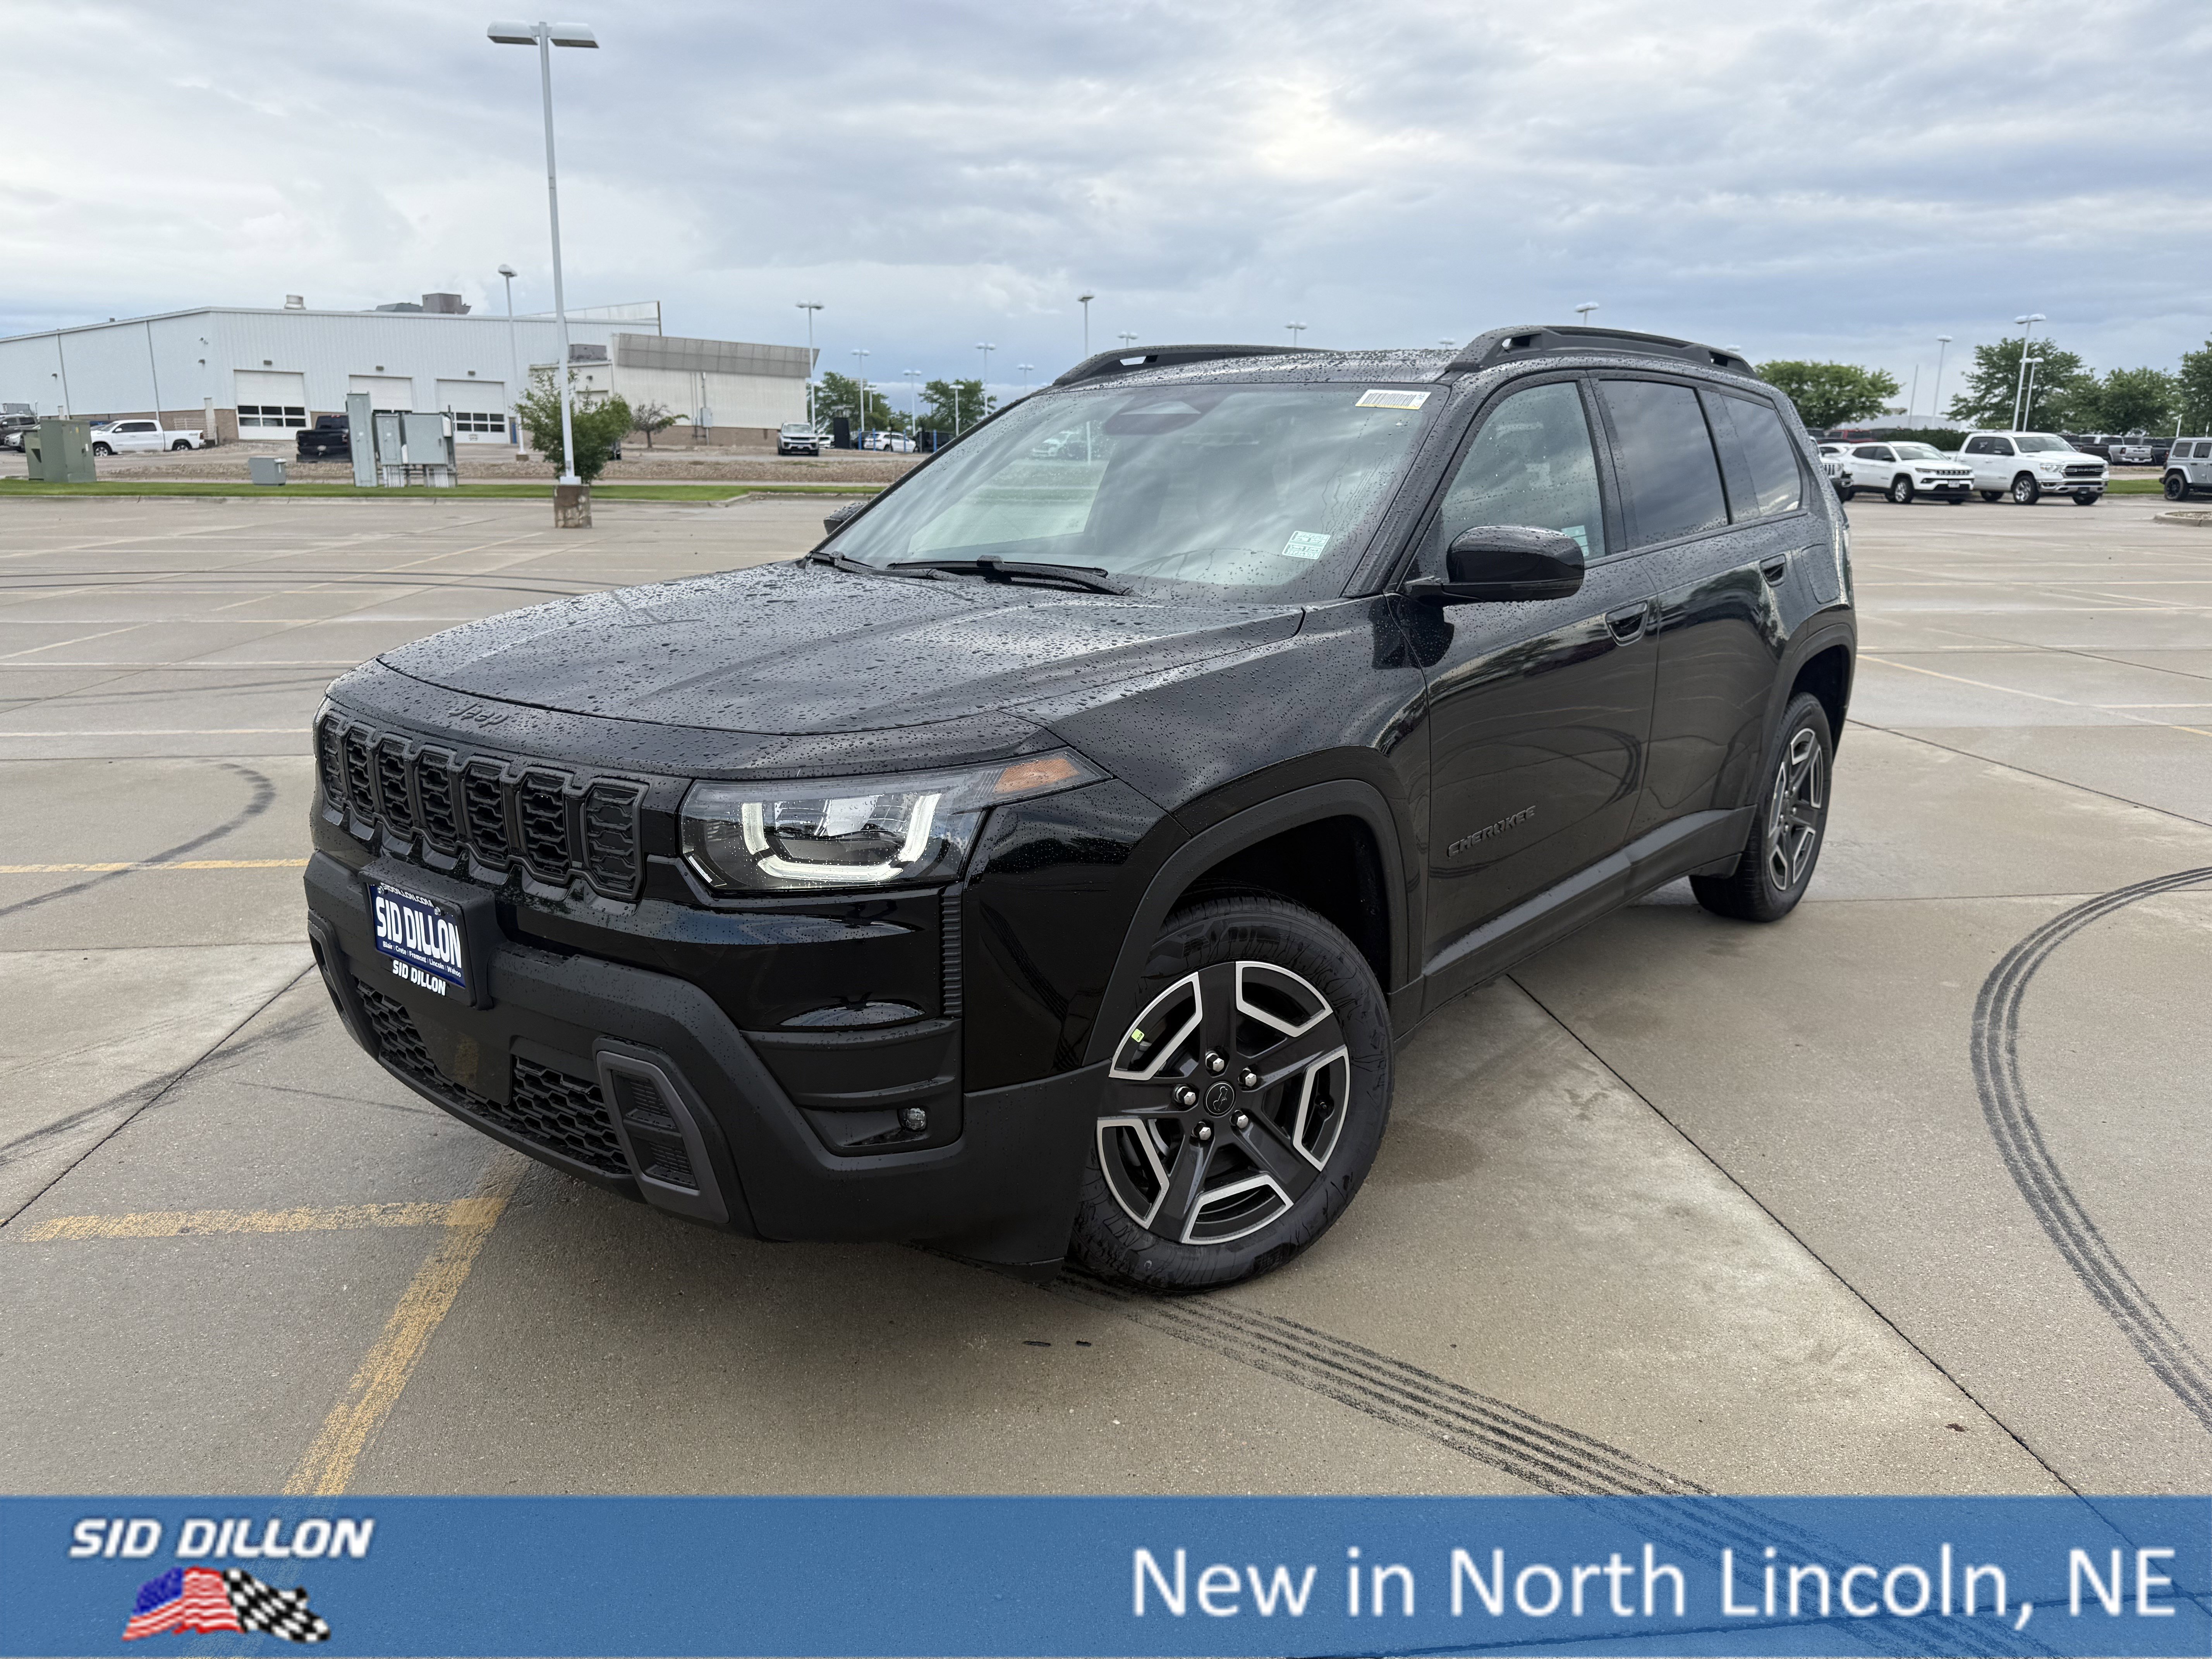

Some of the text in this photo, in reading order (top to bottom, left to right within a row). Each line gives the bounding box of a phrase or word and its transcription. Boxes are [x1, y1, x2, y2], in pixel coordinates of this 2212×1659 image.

[448, 702, 509, 728] Jeep
[1447, 805, 1536, 858] CHEROKEE
[376, 896, 462, 968] SID DILLON
[383, 941, 461, 977] Blair Crete Fremont Lincoln Wahoo
[393, 960, 446, 996] SID DILLON
